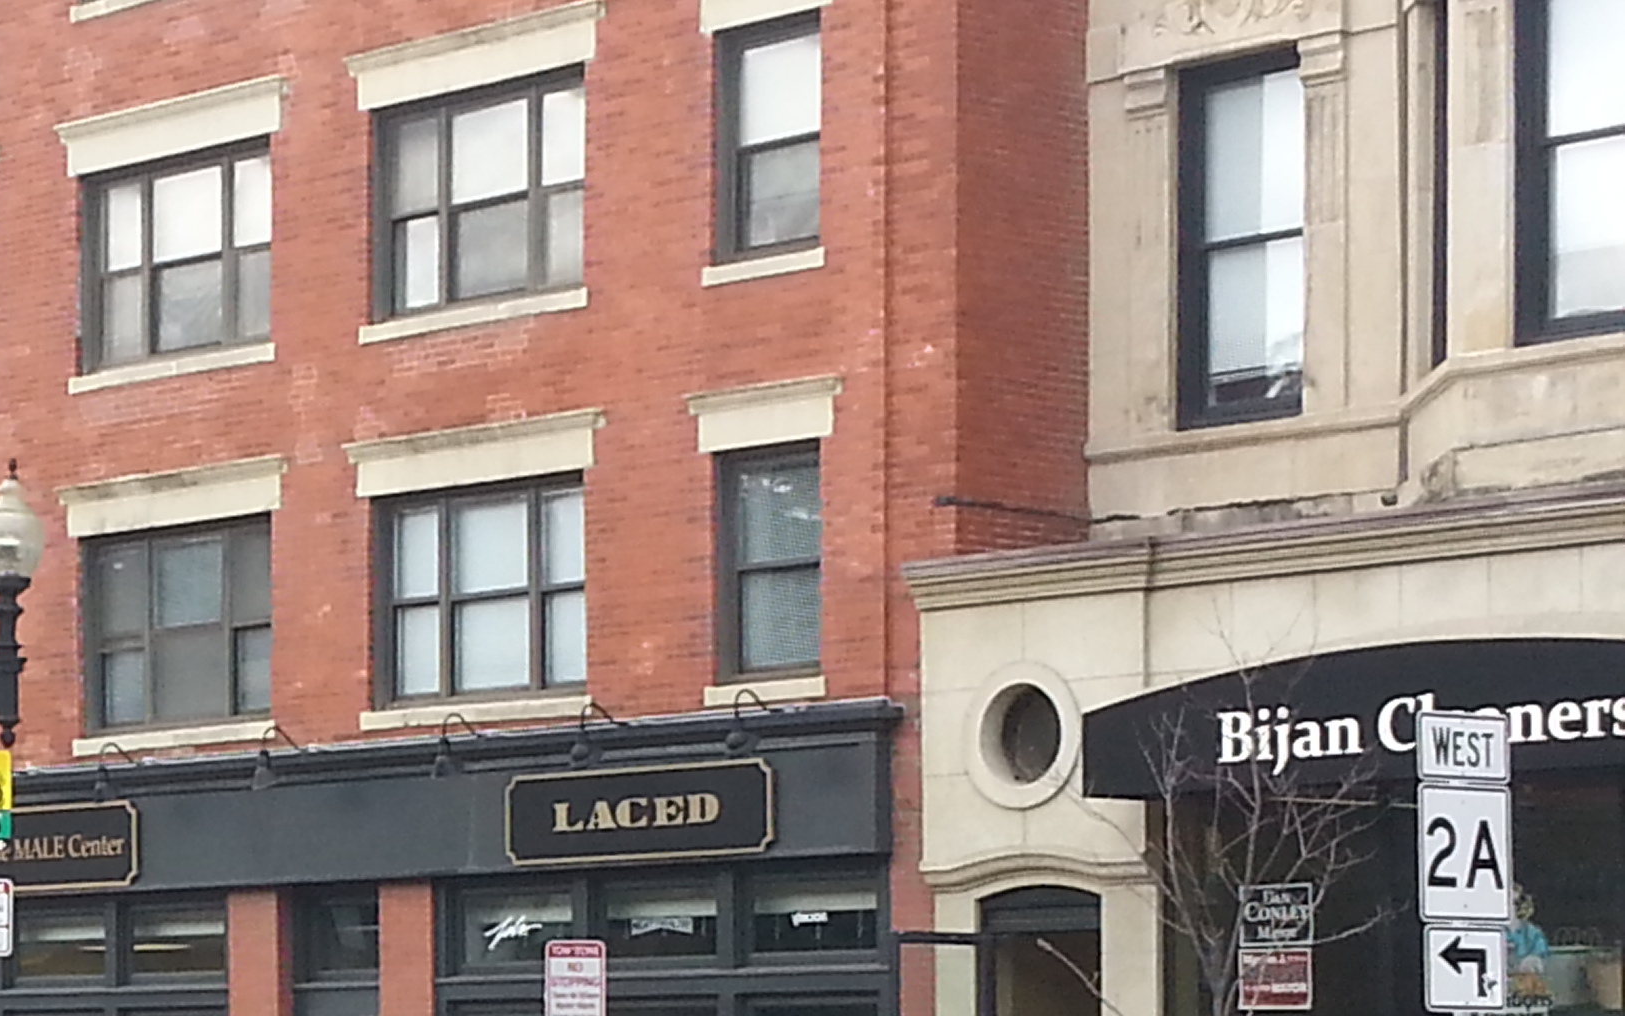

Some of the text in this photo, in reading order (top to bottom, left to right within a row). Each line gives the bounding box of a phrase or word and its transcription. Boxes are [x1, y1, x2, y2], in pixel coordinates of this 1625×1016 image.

[1217, 706, 1363, 776] Bijan
[1432, 726, 1494, 768] WEST
[552, 792, 721, 833] LACED
[13, 834, 65, 860] MALE
[67, 832, 126, 858] Center
[1425, 816, 1505, 890] 2A
